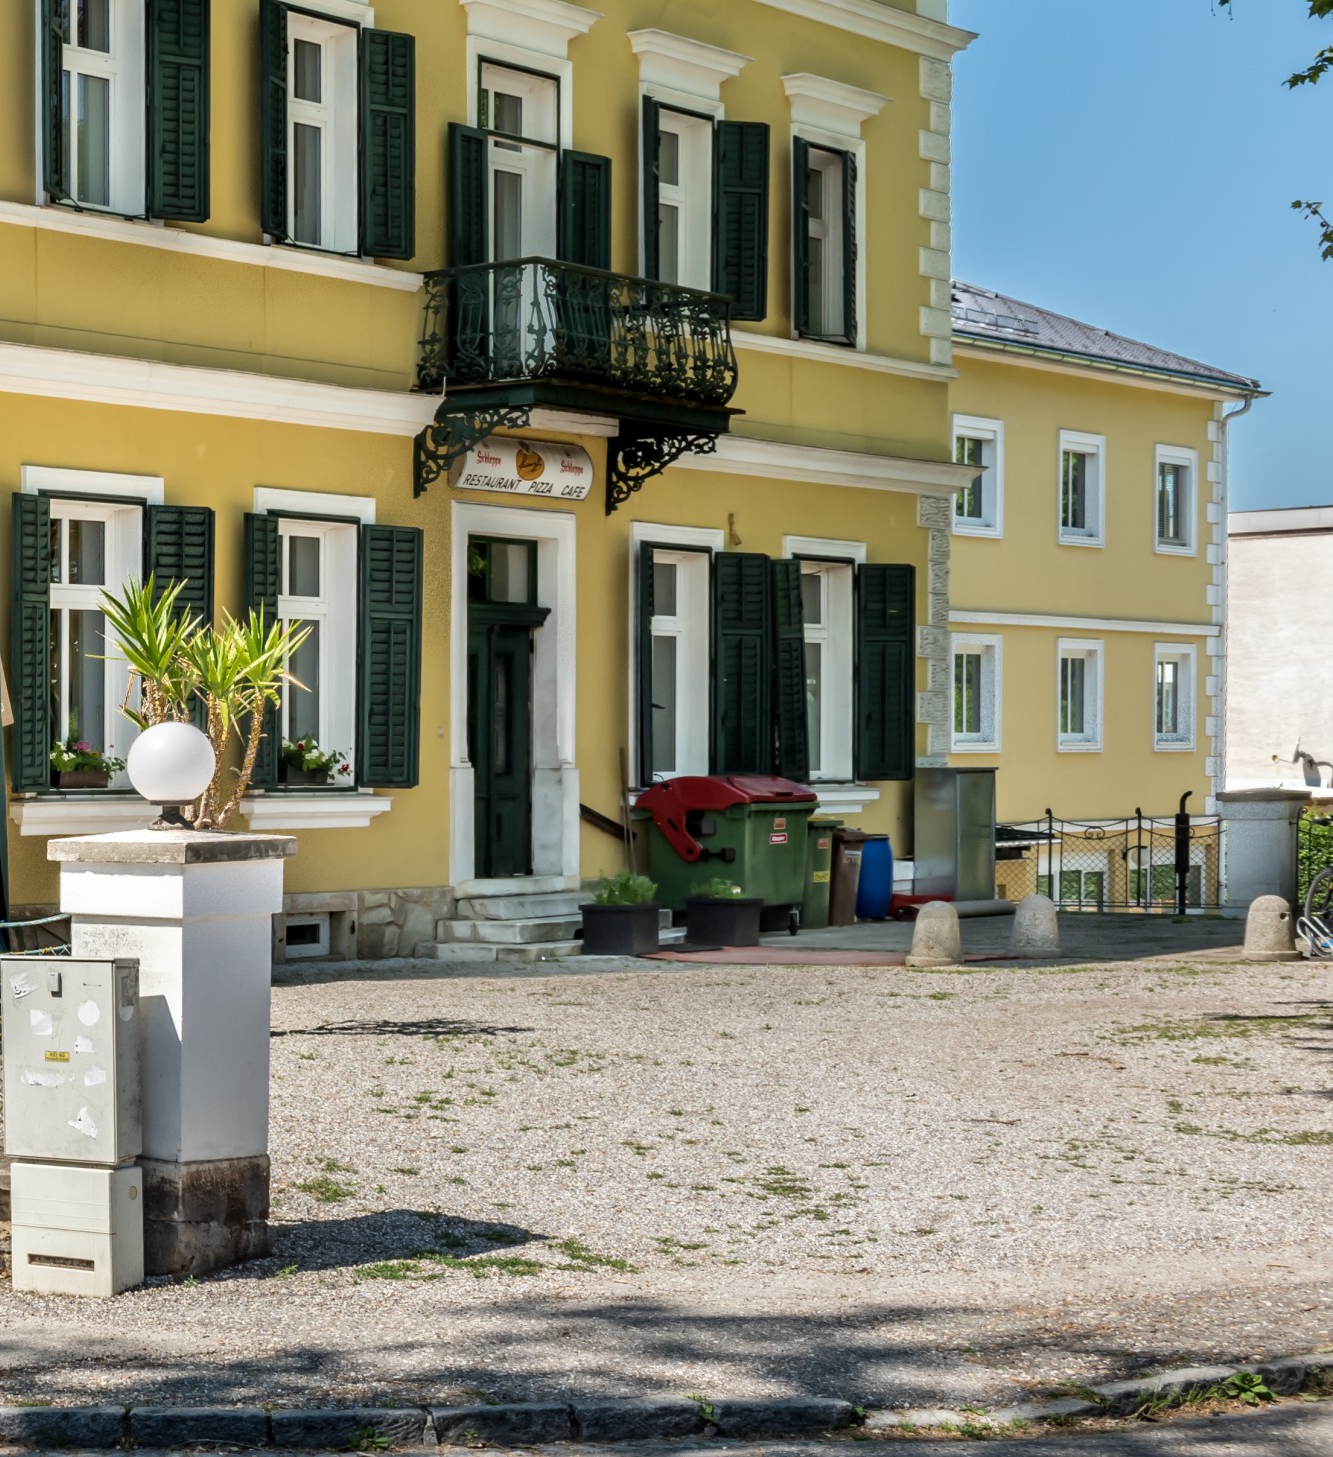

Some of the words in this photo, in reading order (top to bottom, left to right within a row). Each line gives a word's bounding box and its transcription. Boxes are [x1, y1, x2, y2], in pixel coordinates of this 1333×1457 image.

[477, 450, 502, 467] Schleppe
[463, 474, 522, 490] RESTAURANT
[528, 481, 553, 494] PIZZA
[561, 485, 586, 498] CAFE
